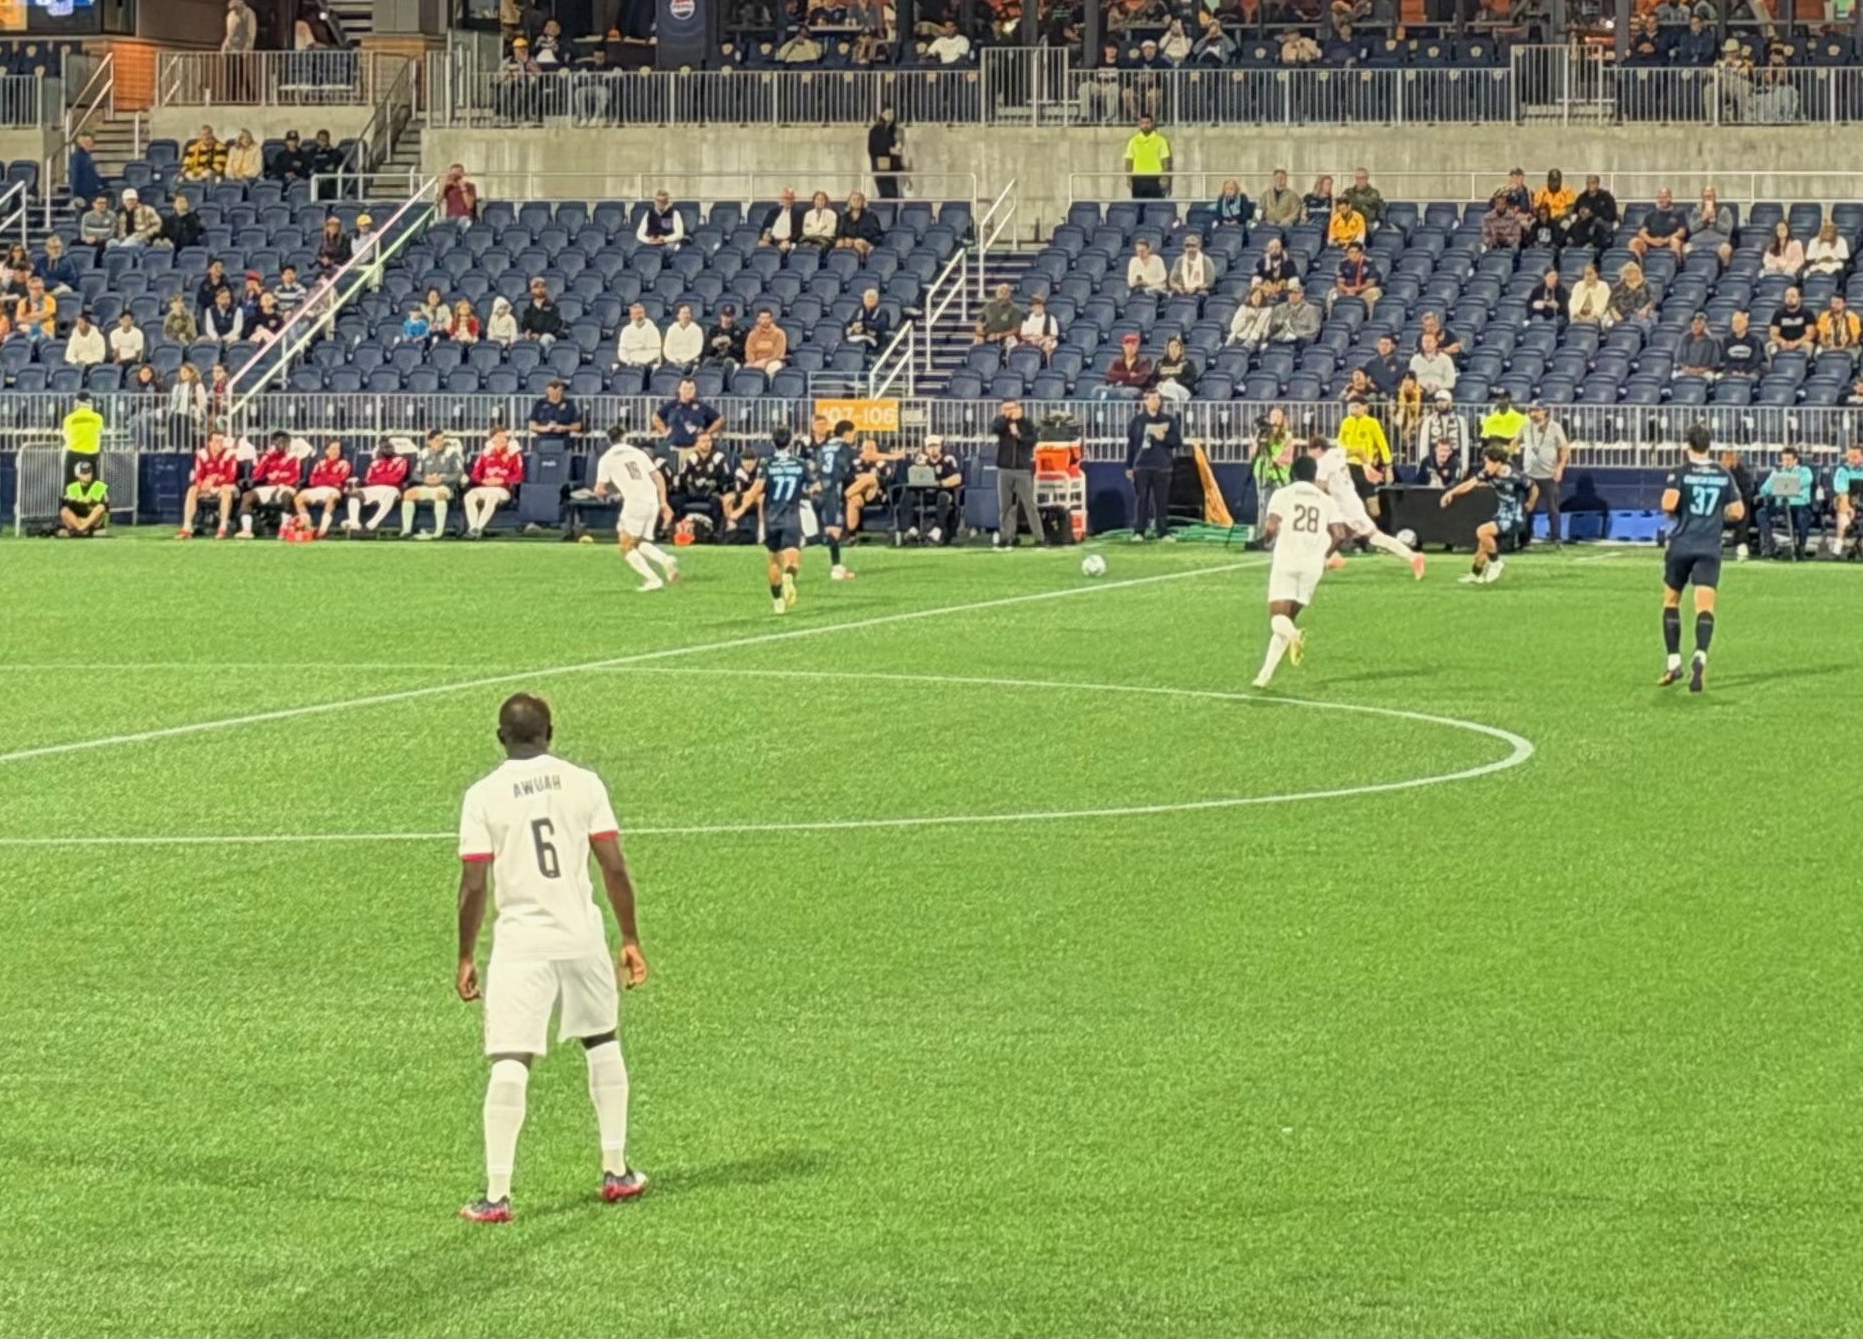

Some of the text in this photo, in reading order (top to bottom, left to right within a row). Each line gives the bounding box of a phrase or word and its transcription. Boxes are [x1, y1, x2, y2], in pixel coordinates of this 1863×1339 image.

[822, 452, 835, 474] 3
[773, 475, 797, 501] 77
[1689, 485, 1720, 516] 37
[1293, 504, 1319, 533] 28
[512, 775, 561, 798] AWUAH
[531, 817, 561, 879] 6
